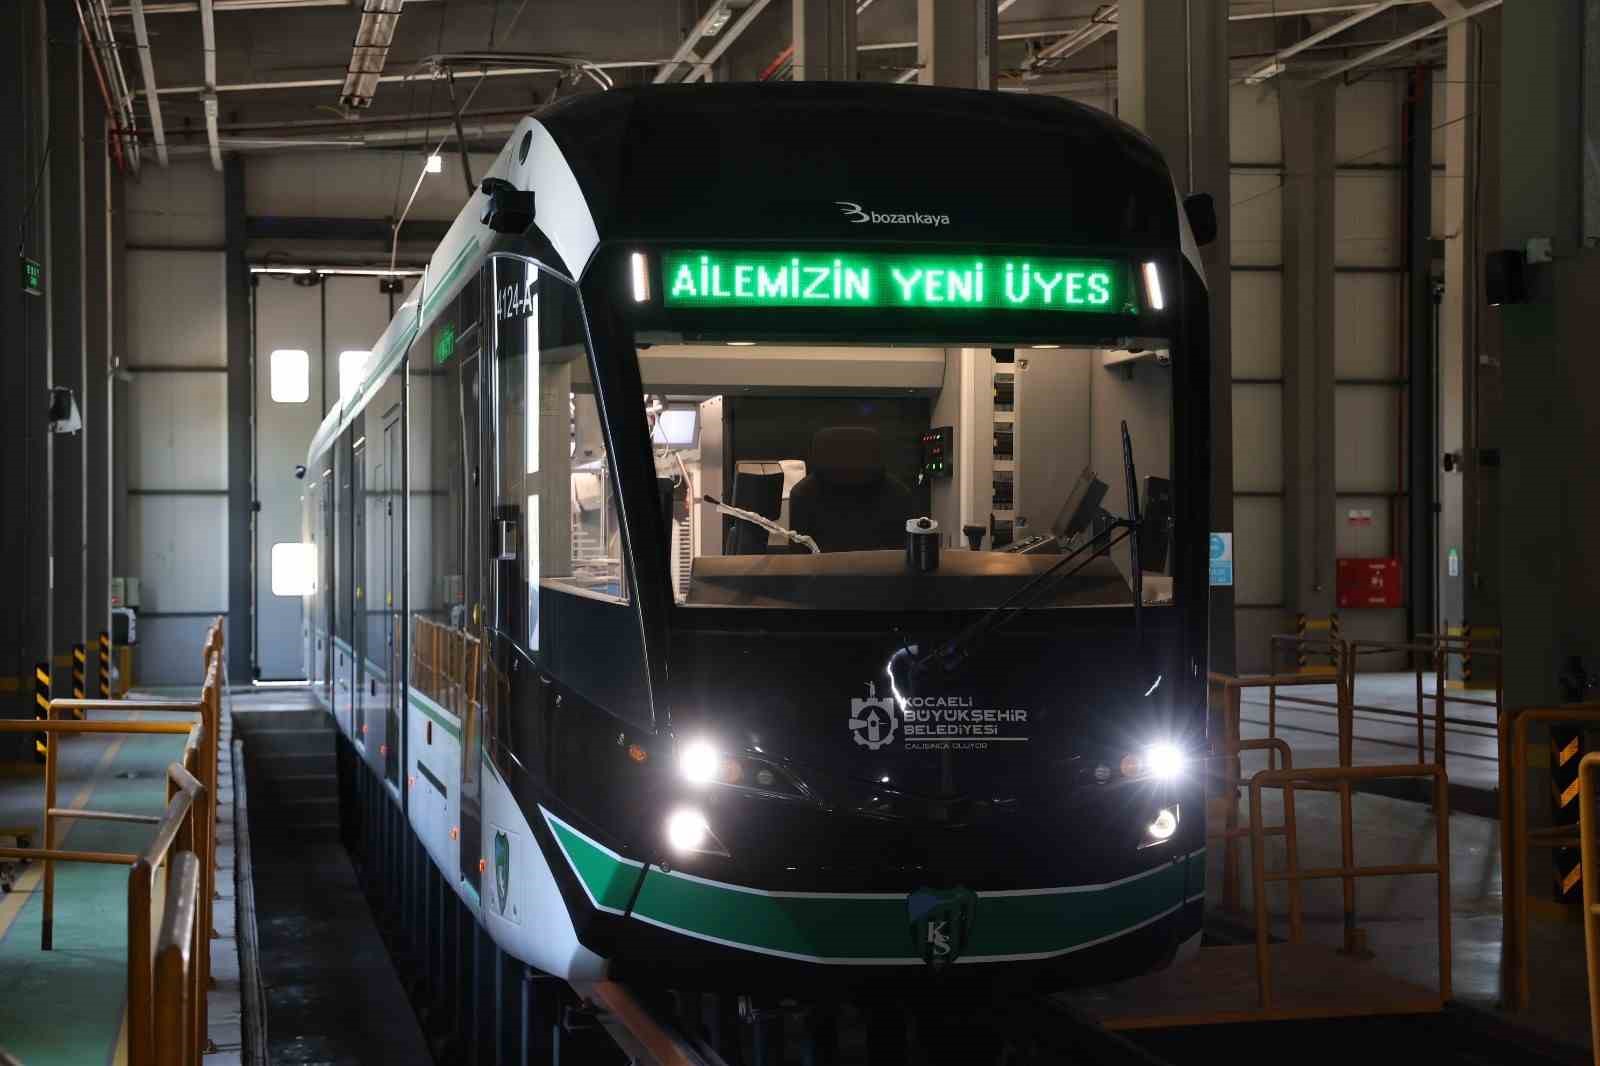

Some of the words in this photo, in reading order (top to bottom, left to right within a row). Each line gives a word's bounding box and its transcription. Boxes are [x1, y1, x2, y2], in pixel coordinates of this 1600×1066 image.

[871, 211, 950, 227] bozankaya
[672, 256, 870, 300] AİLEMİZİN
[891, 262, 984, 303] YENİ
[1005, 263, 1110, 305] ÜYES
[497, 283, 533, 320] 4124-A
